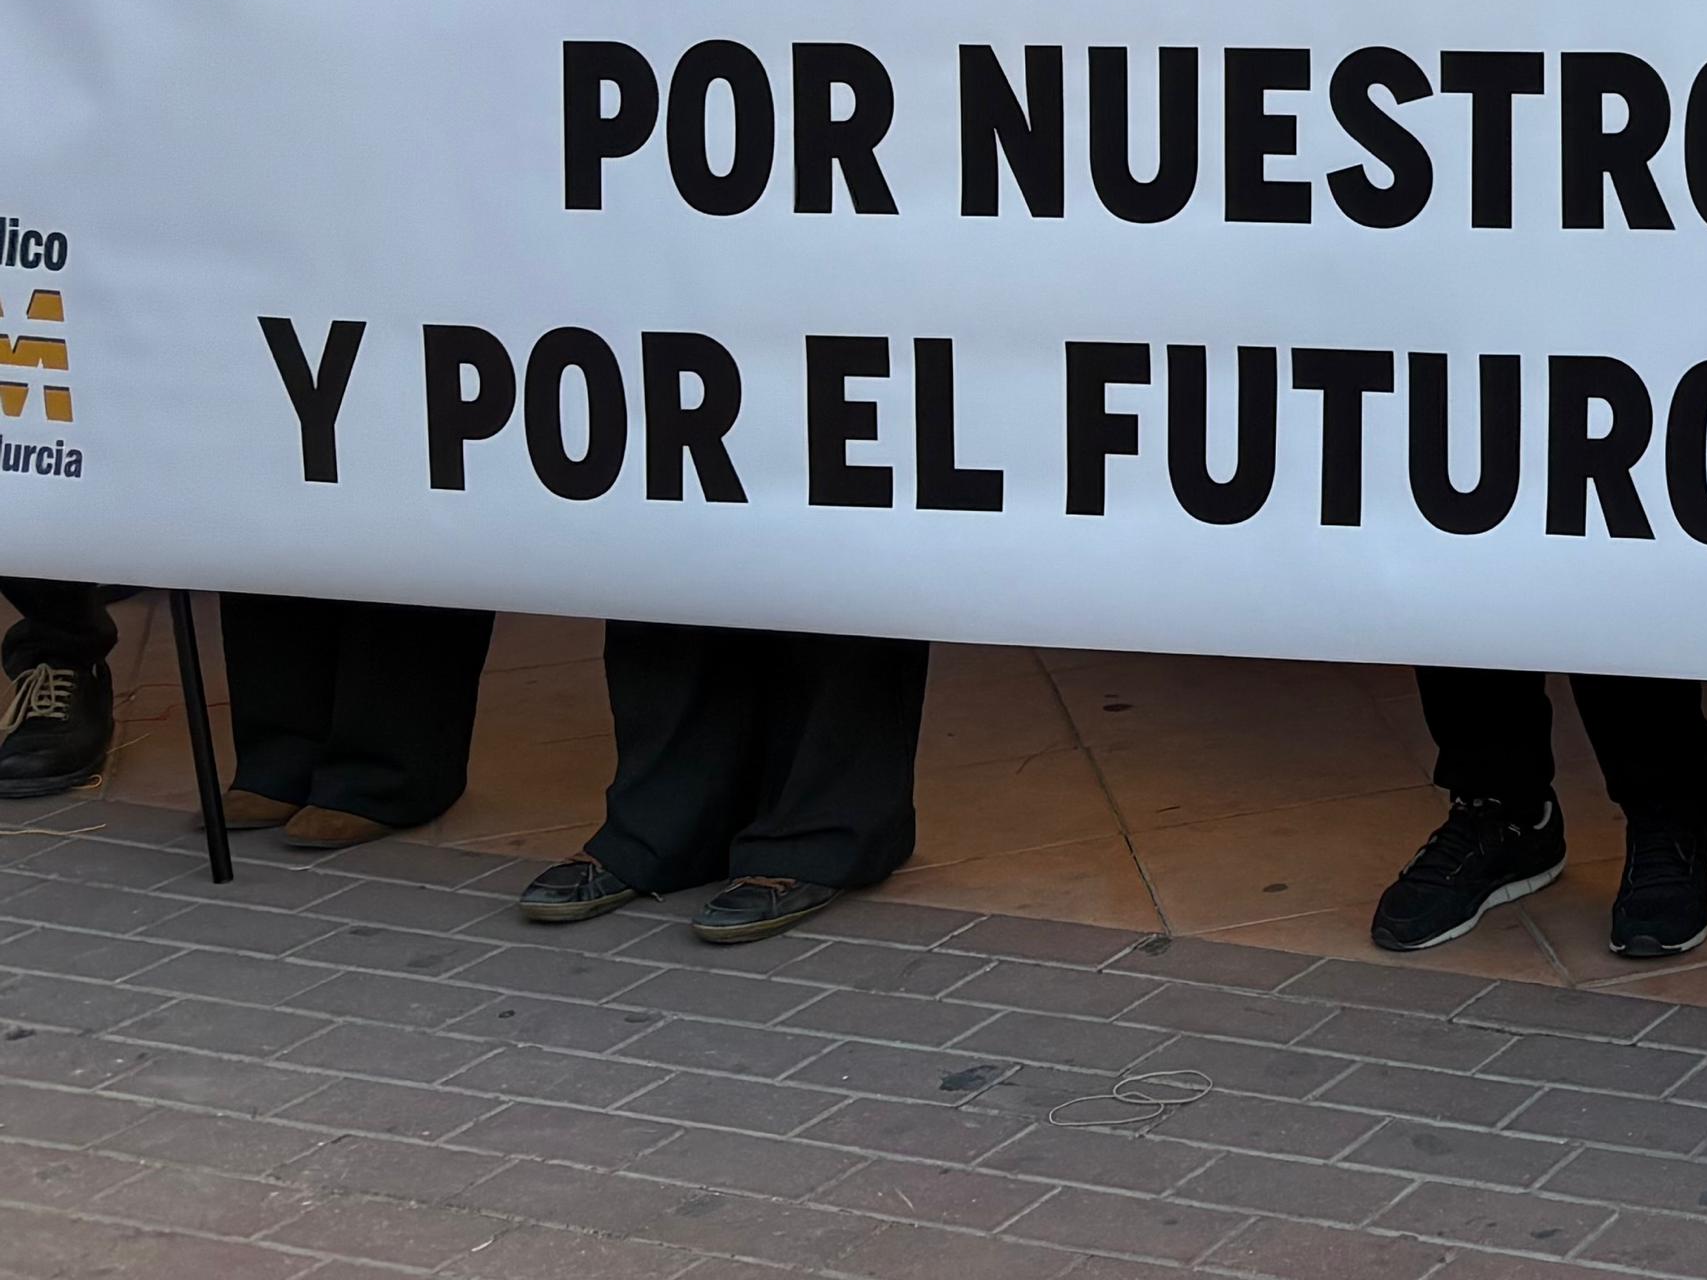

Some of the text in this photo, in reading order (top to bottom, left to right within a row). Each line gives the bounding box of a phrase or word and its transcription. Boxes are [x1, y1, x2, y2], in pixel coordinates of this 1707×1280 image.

[563, 39, 899, 219] POR
[259, 317, 367, 486] Y
[423, 323, 750, 506] POR
[806, 333, 1004, 513] EL
